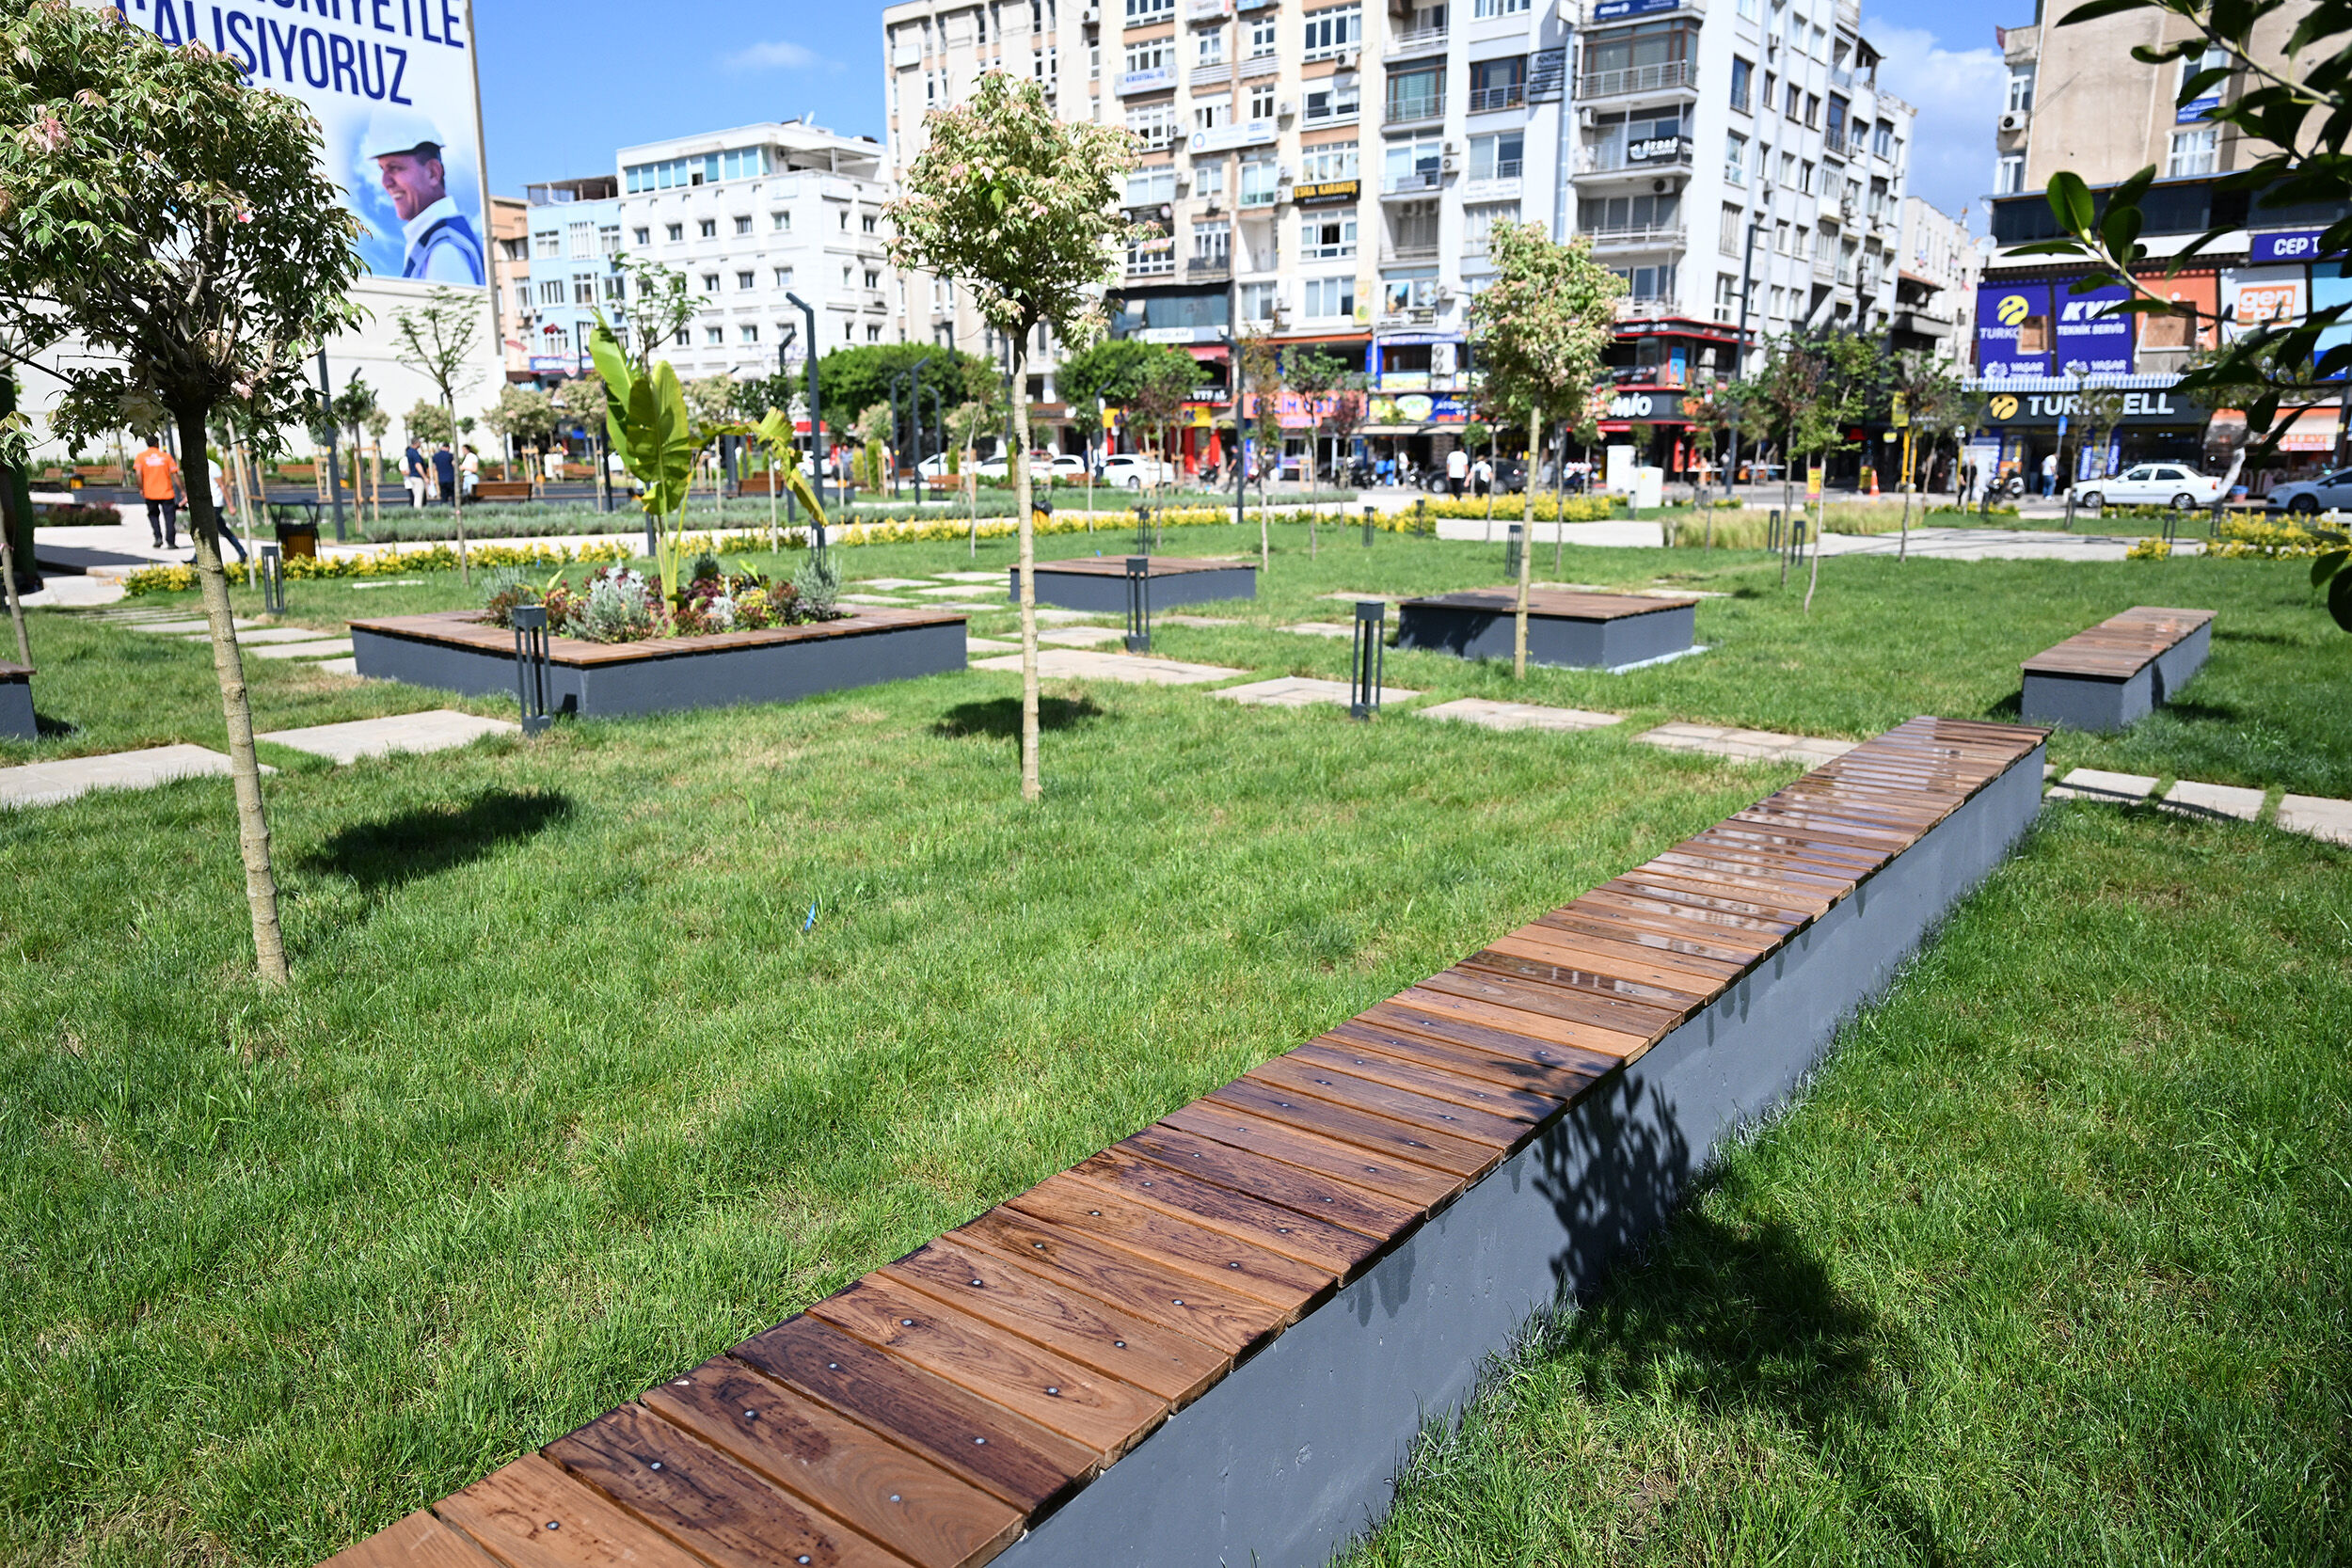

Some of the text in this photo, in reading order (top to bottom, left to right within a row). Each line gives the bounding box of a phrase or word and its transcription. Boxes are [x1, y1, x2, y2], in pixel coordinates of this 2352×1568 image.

[2273, 237, 2309, 256] CEP
[2240, 290, 2294, 313] gen
[2027, 392, 2175, 416] TURELL
